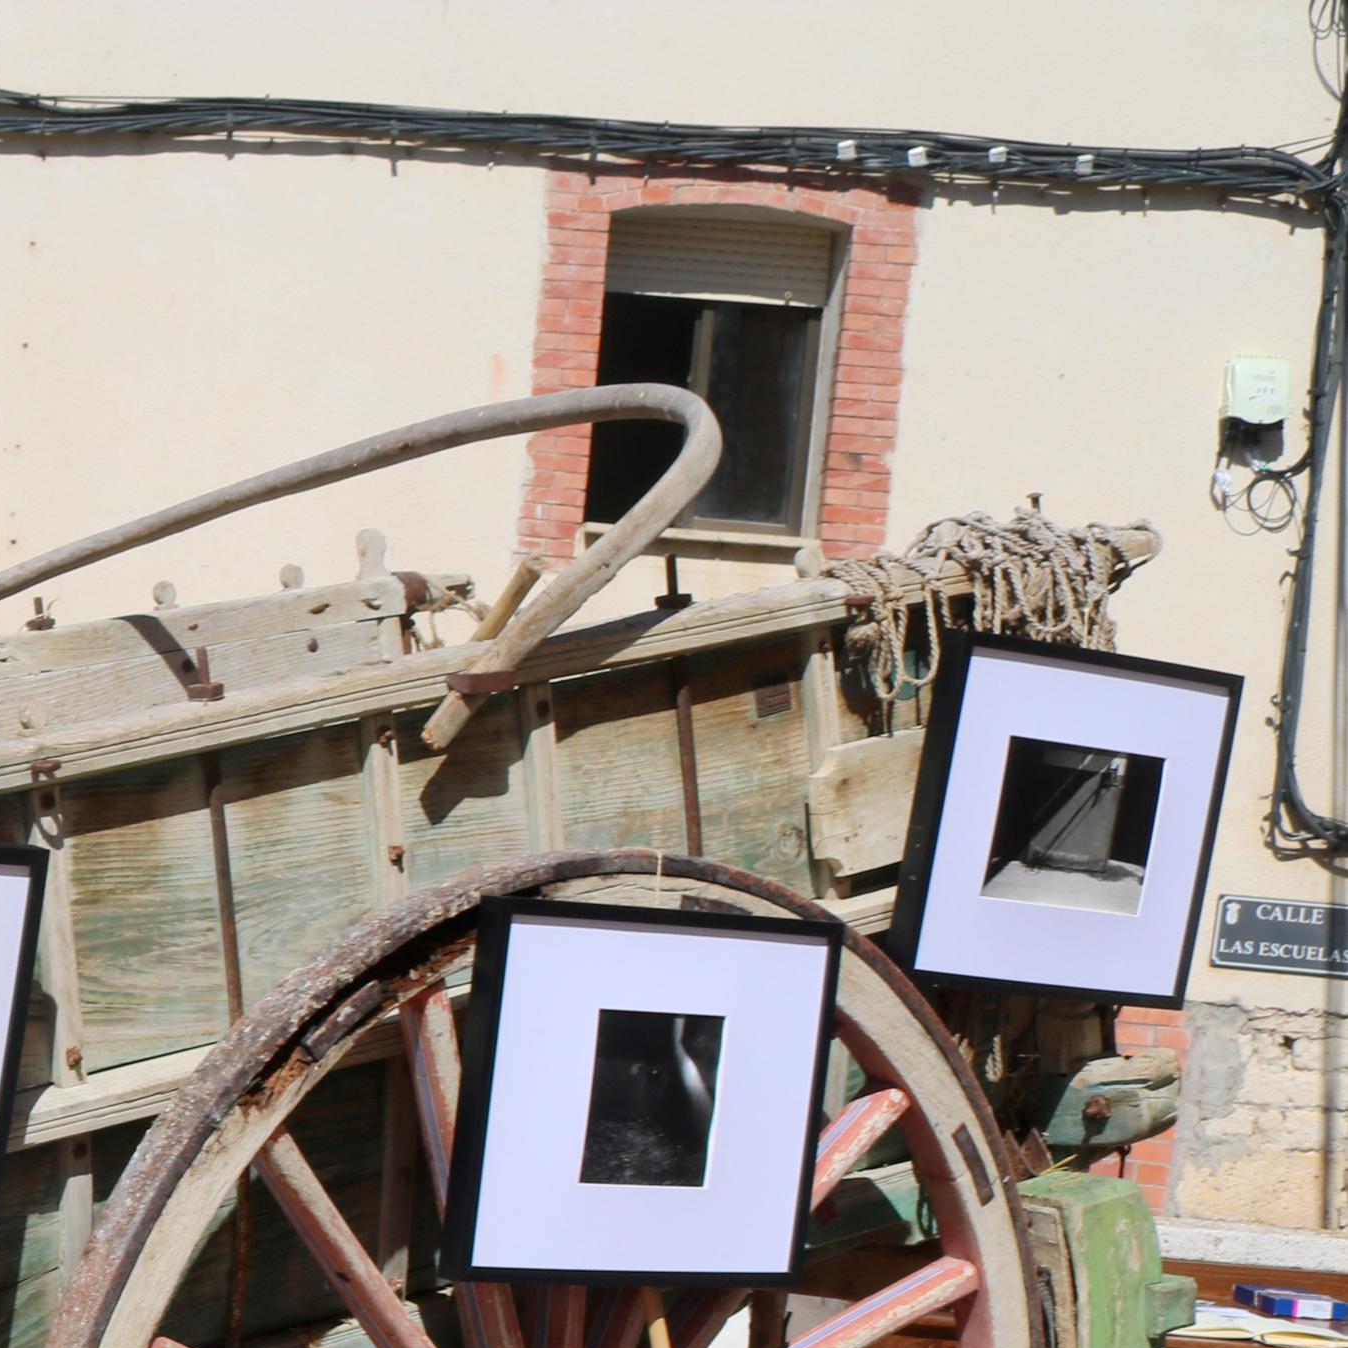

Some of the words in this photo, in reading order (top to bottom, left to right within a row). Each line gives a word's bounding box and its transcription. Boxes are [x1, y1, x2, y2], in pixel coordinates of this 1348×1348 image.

[1255, 903, 1325, 925] CALLE
[1218, 938, 1255, 955] LAS
[1258, 941, 1348, 963] ESCUELAS
